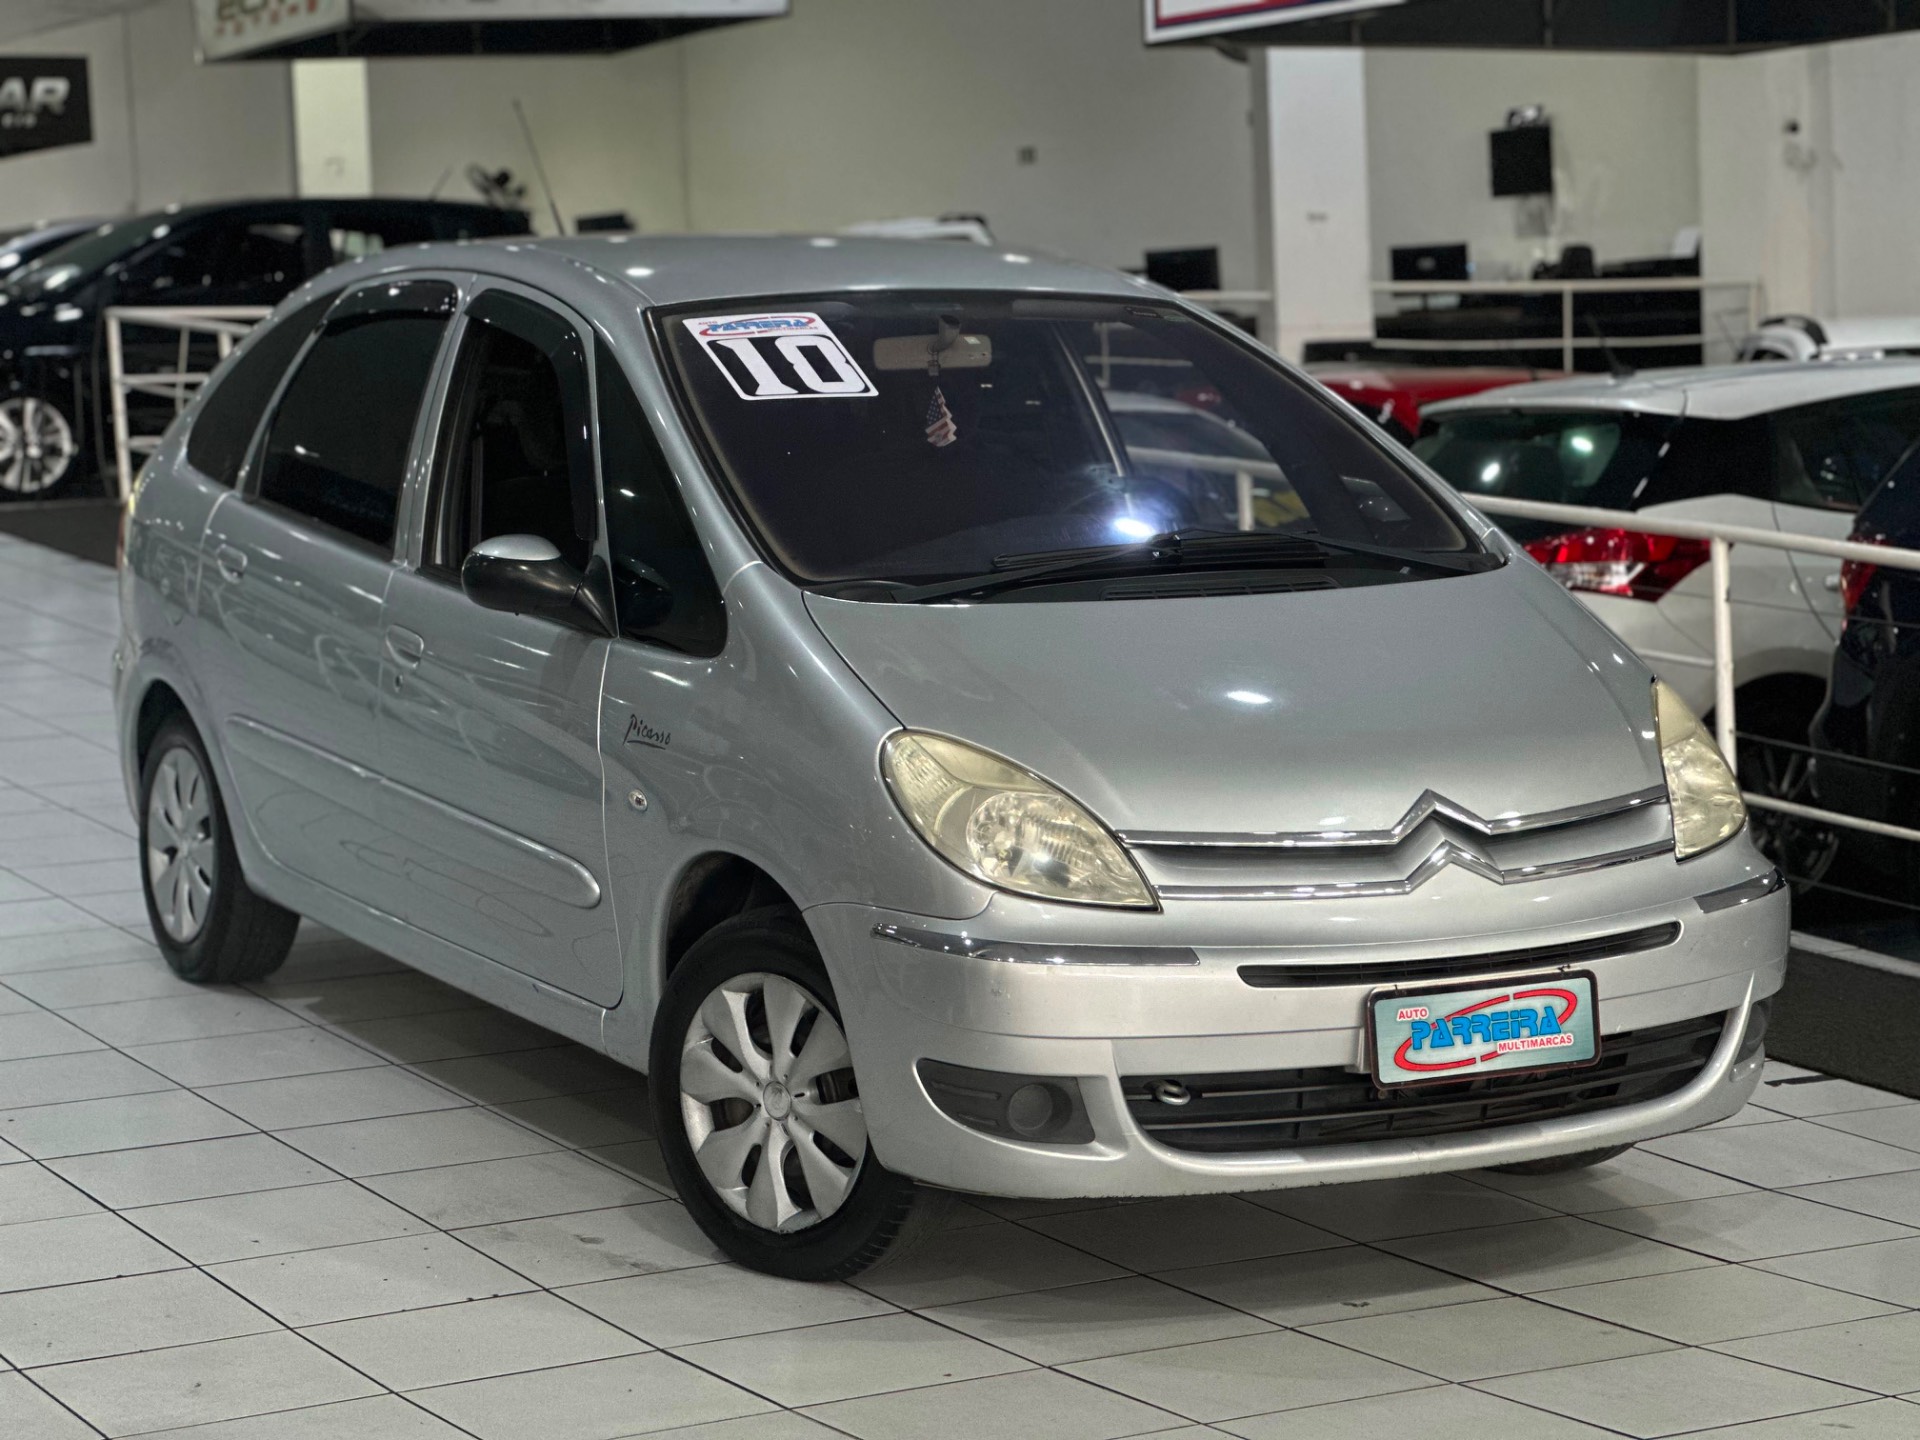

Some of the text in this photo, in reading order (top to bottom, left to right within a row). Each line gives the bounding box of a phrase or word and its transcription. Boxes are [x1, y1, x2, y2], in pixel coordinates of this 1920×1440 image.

[715, 336, 866, 396] 10
[622, 713, 671, 746] Picasso
[1397, 1008, 1428, 1020] AUTO
[1411, 1006, 1562, 1051] PARREIRA
[1498, 1035, 1573, 1052] MULTIMARCAS
